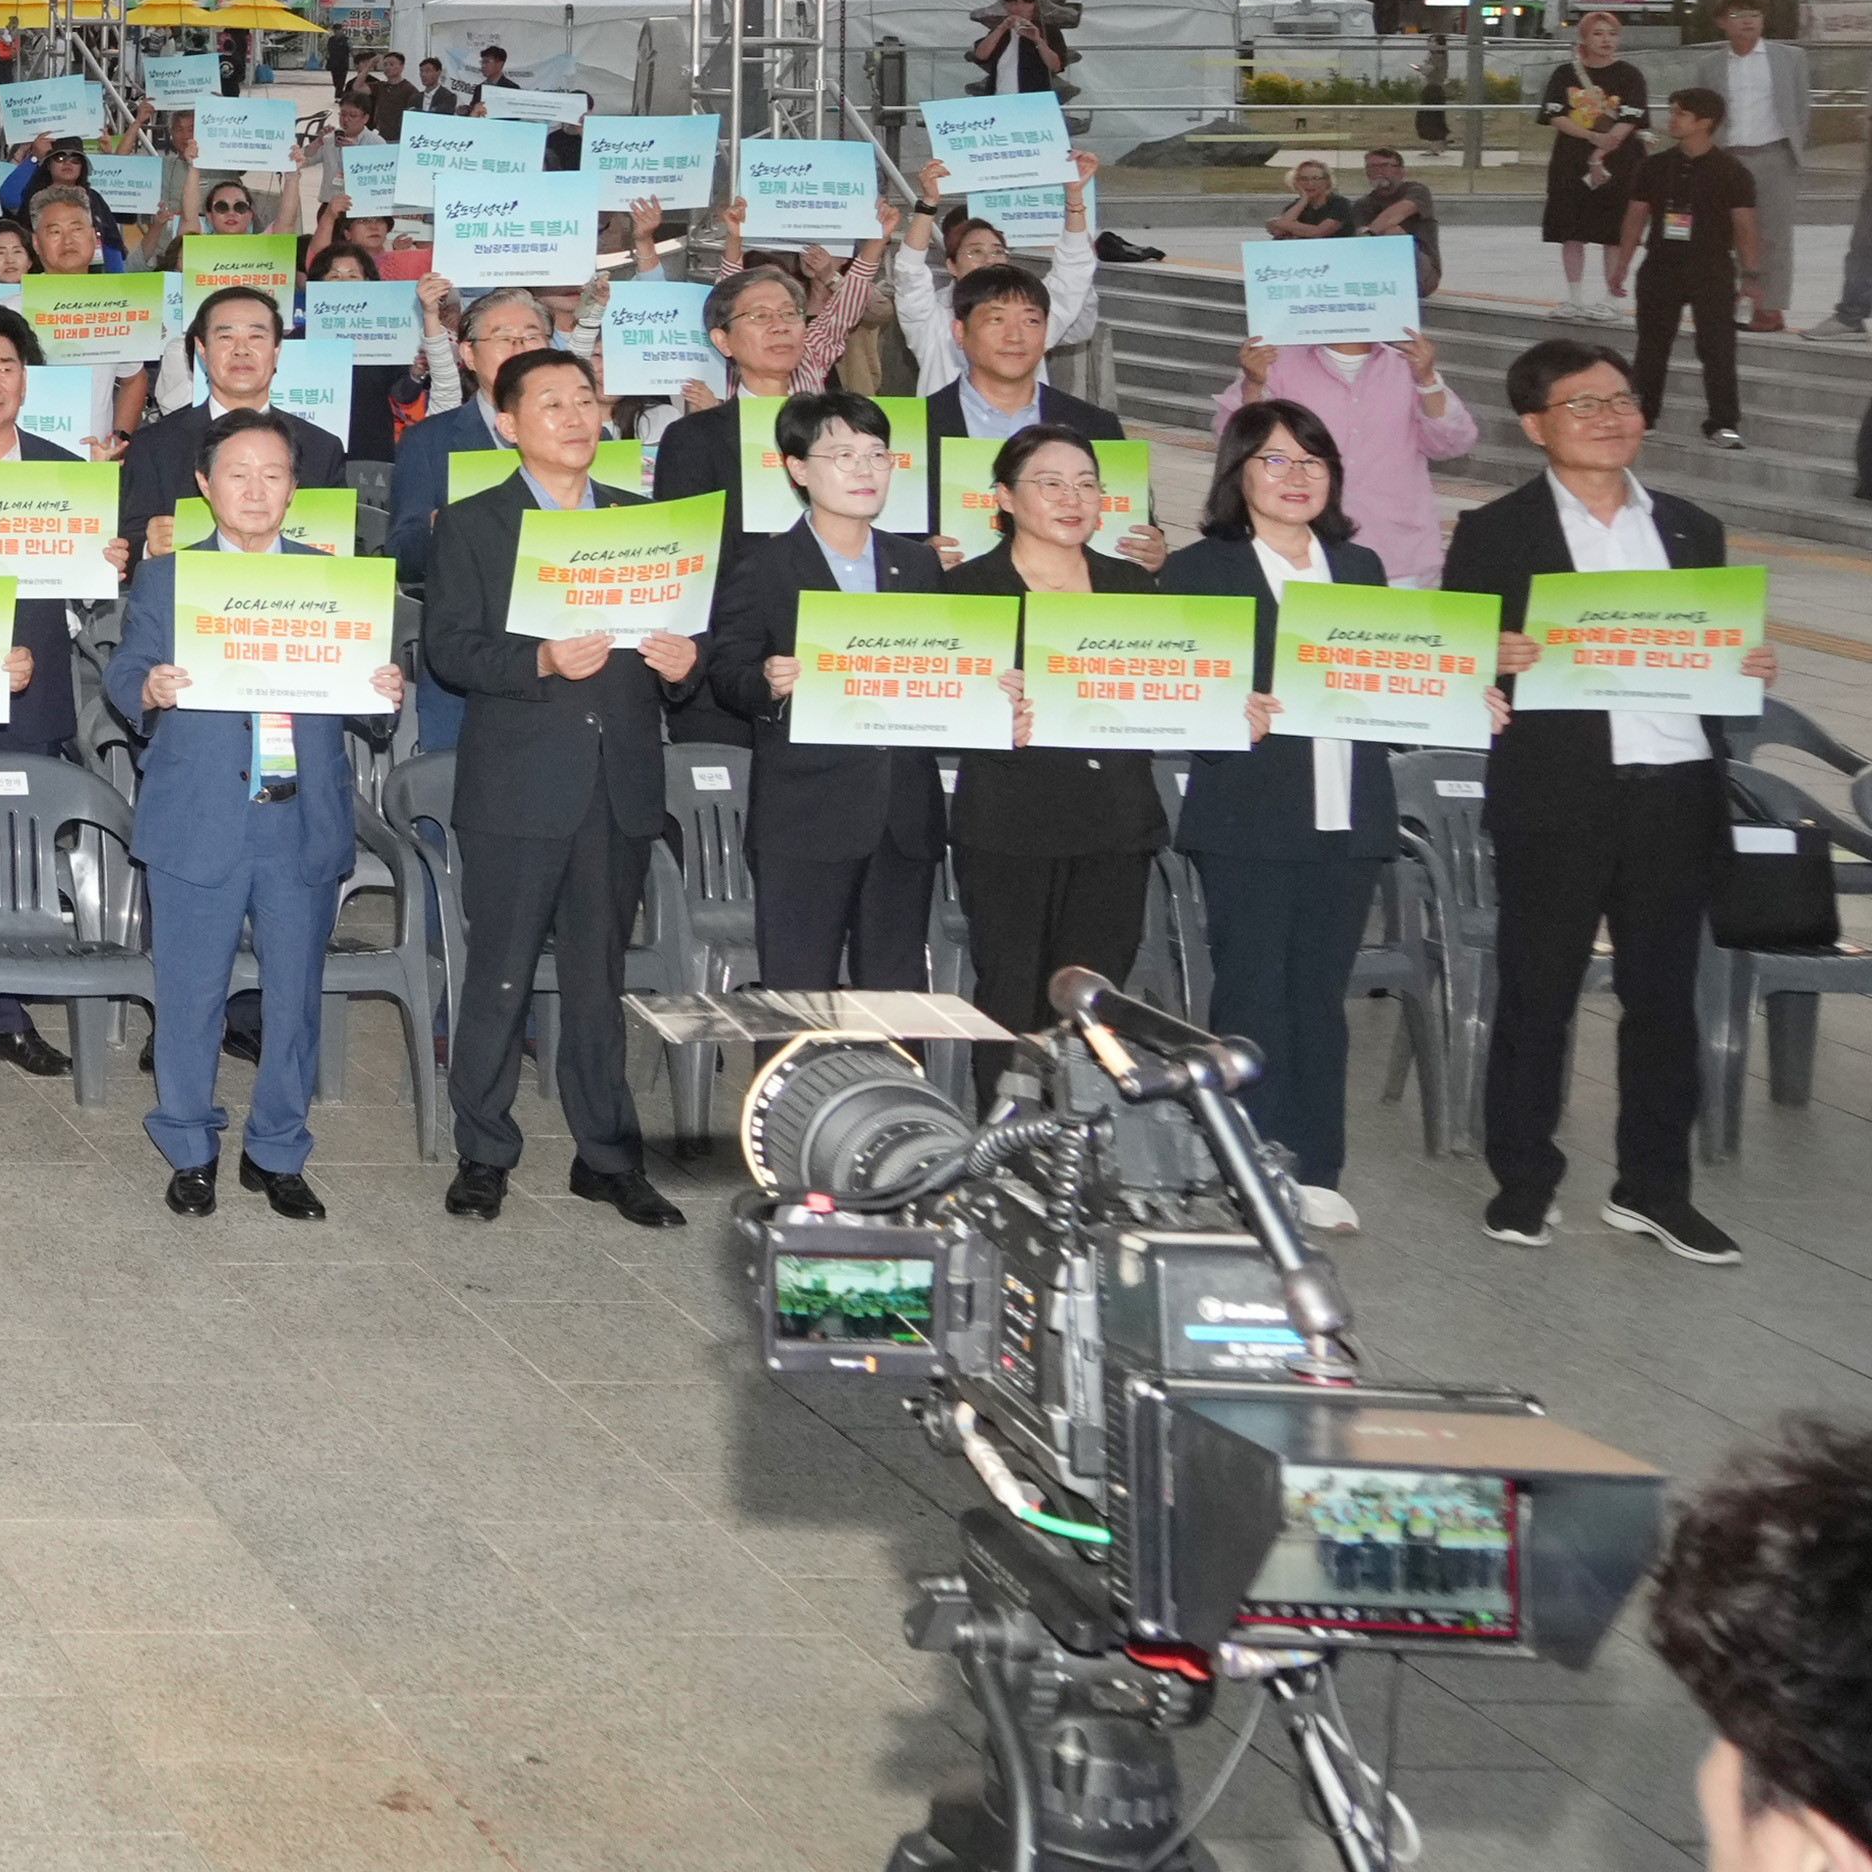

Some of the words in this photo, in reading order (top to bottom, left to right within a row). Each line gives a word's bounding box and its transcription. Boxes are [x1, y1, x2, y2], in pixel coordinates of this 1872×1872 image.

[349, 10, 372, 20] 의성
[453, 221, 488, 238] 함께
[492, 221, 525, 237] 사는
[529, 219, 579, 237] 특별시
[473, 242, 558, 254] 전남광주통합특별시
[223, 596, 295, 614] LOCAL에서
[298, 598, 343, 614] 세계로
[1662, 610, 1714, 624] 세계로
[195, 615, 328, 639] 문화예술관광의
[333, 619, 372, 640] 물결
[1542, 625, 1696, 646] 문화예술관광의
[1701, 628, 1746, 647] 물결
[845, 634, 918, 651] LOCAL에서
[920, 636, 965, 651] 세계로
[1076, 636, 1152, 653] LOCAL에서
[1156, 638, 1202, 653] 세계로
[1402, 631, 1448, 649] 세계로
[223, 641, 279, 662] 미래를
[284, 643, 342, 663] 만나다
[1296, 643, 1432, 672] 문화예술관광의
[1437, 653, 1476, 675] 물결
[1571, 649, 1637, 667] 미래를
[1643, 650, 1711, 669] 만나다
[816, 653, 950, 674] 문화예술관광의
[954, 656, 993, 675] 물결
[1046, 655, 1186, 677] 문화예술관광의
[1192, 658, 1231, 678] 물결
[842, 678, 900, 698] 미래를
[905, 679, 963, 699] 만나다
[1076, 681, 1135, 700] 미래를
[1142, 682, 1202, 701] 만나다
[1323, 670, 1381, 693] 미래를
[1387, 675, 1446, 697] 만나다
